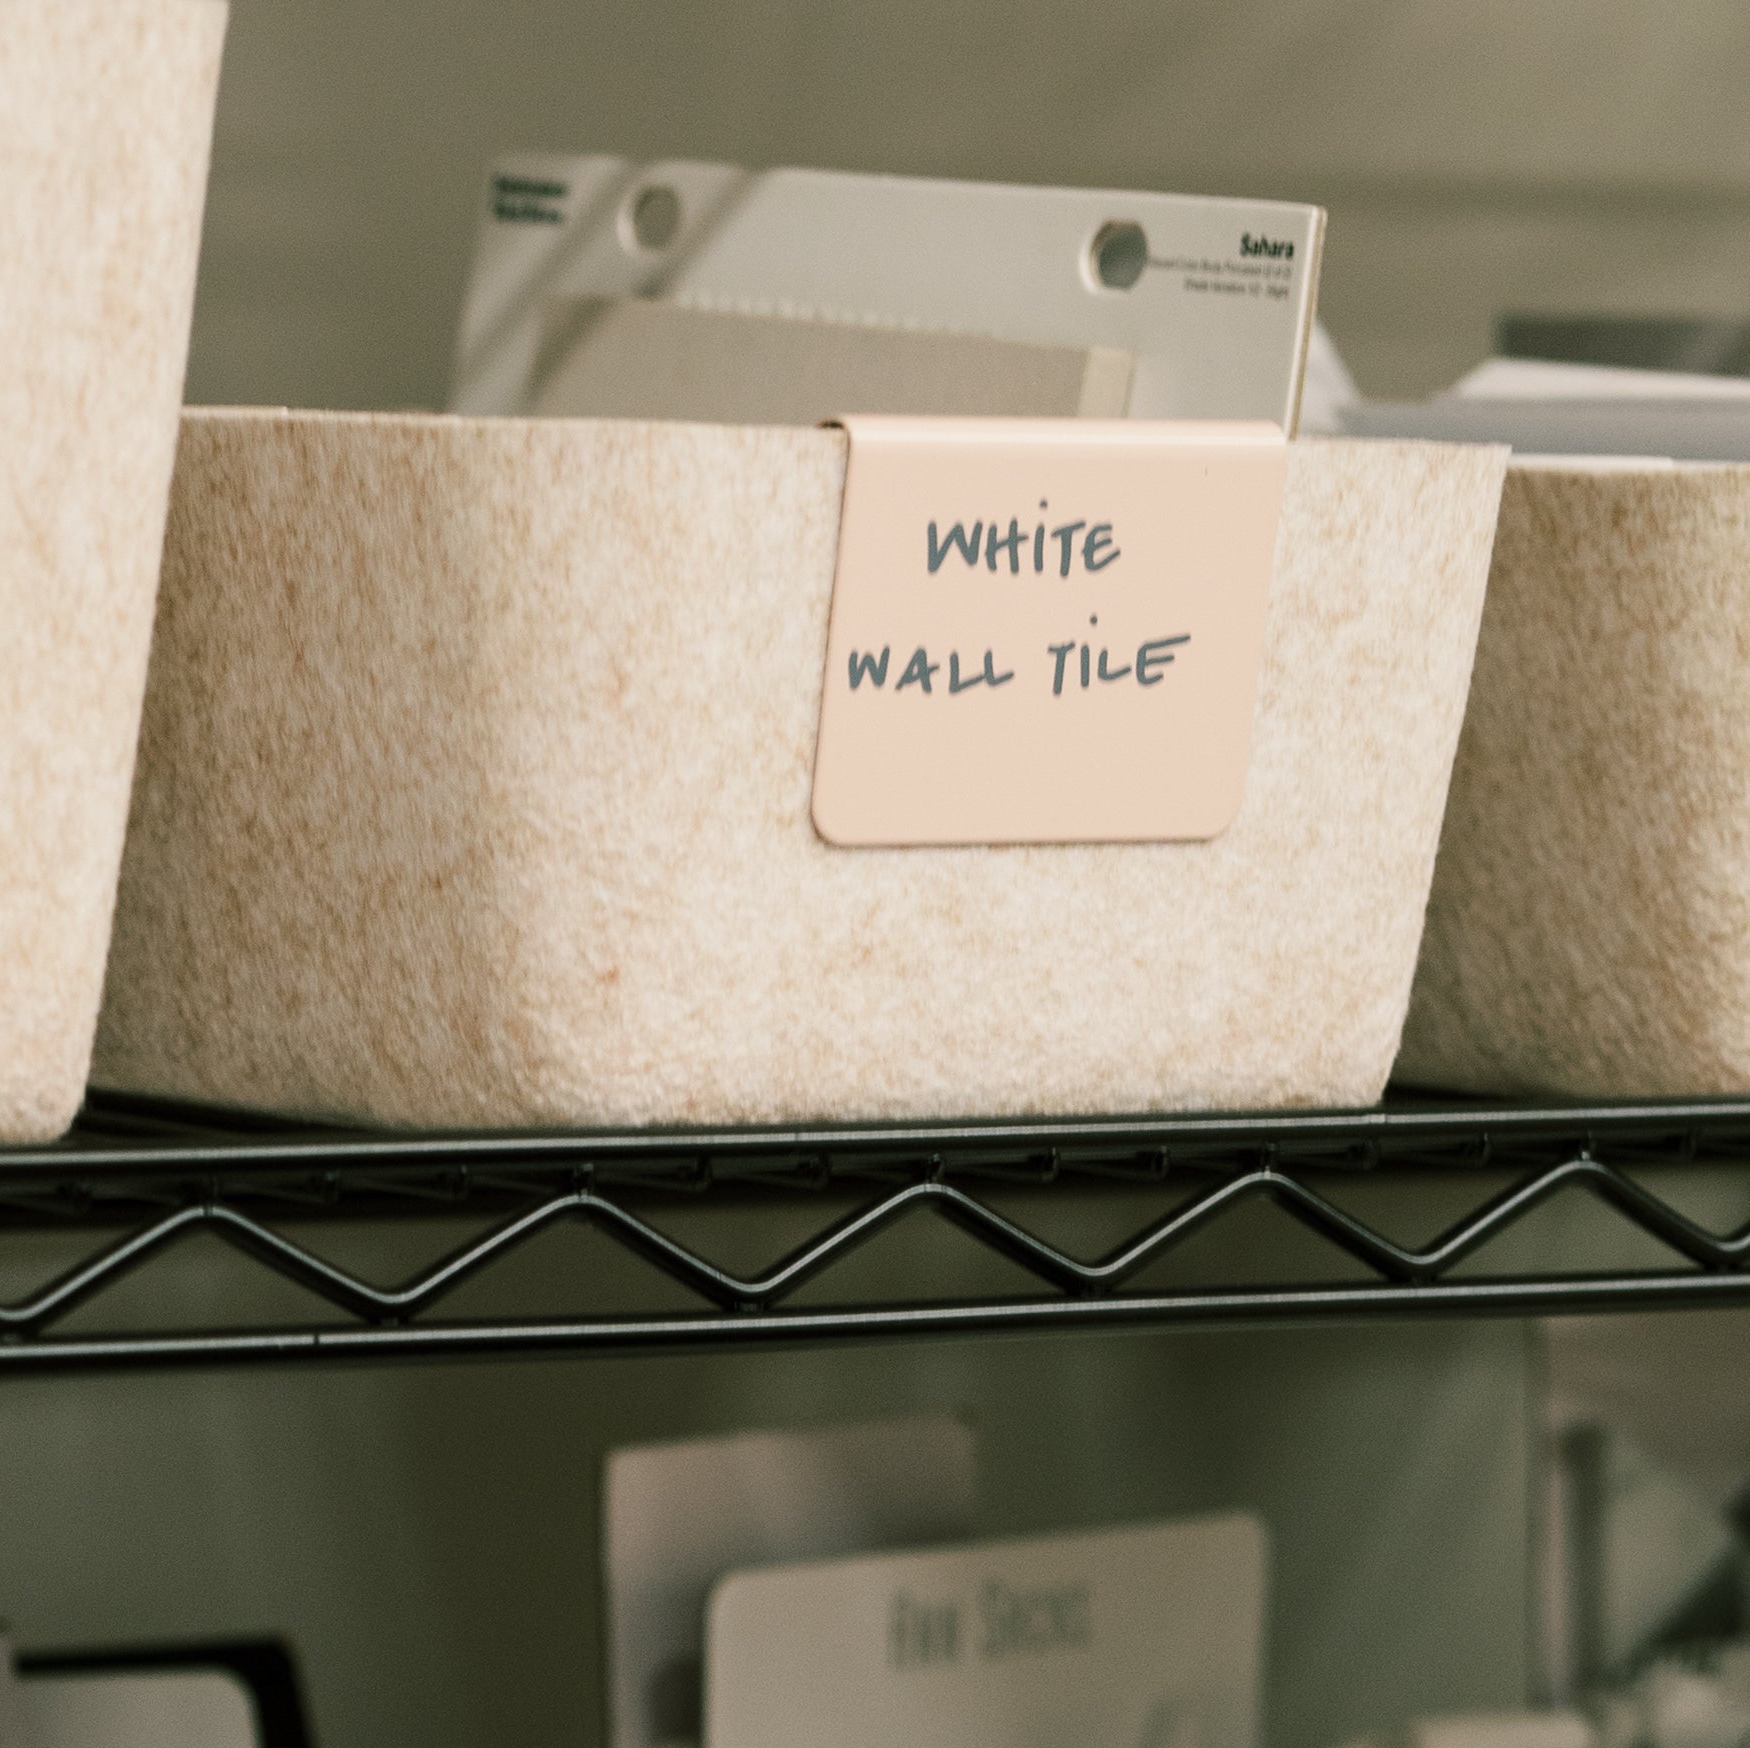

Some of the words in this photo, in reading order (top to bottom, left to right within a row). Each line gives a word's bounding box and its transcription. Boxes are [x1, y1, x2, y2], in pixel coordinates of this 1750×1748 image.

[1240, 232, 1294, 259] Sahara
[926, 499, 1121, 578] WHITE
[848, 645, 1015, 694] WALL
[1047, 613, 1191, 696] TILE
